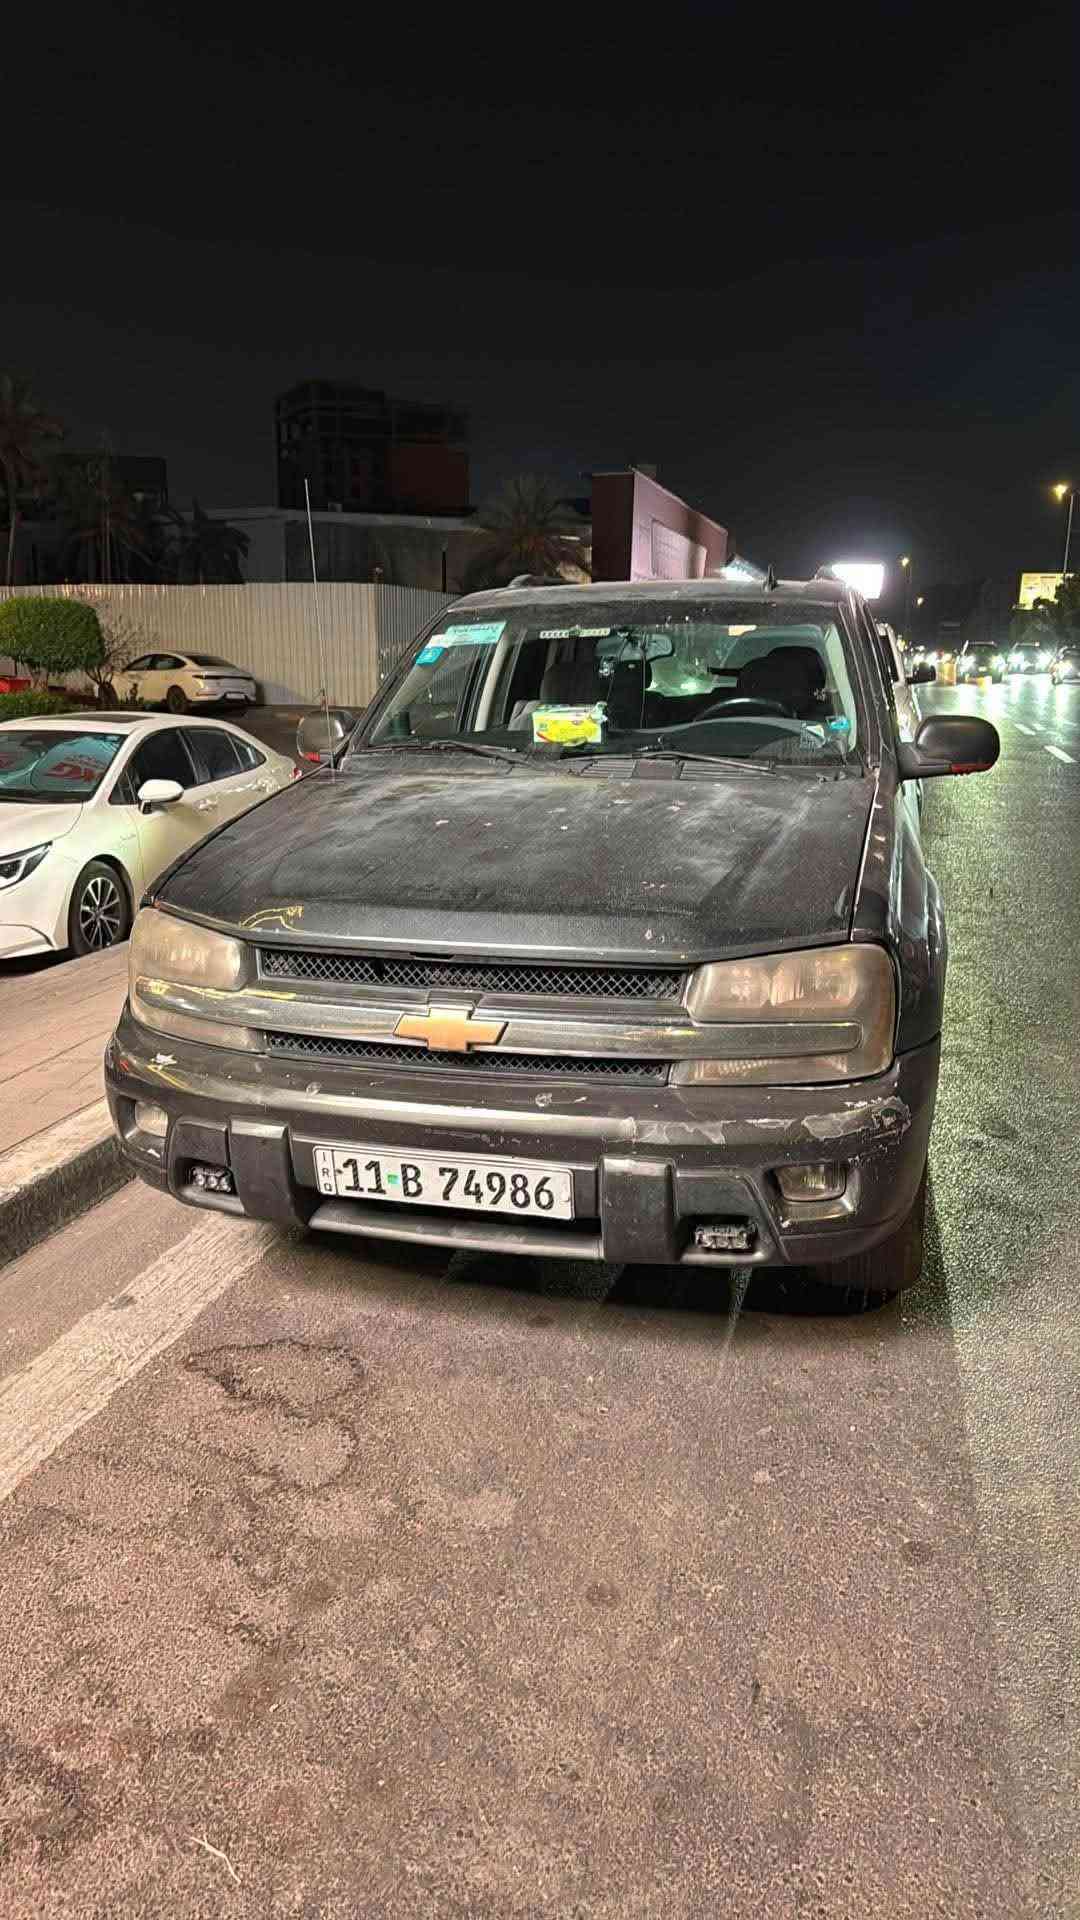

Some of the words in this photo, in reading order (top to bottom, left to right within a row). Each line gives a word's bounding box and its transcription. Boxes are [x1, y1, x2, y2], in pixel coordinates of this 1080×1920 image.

[342, 1158, 387, 1195] 11
[400, 1163, 423, 1198] B
[438, 1166, 555, 1211] 74986
